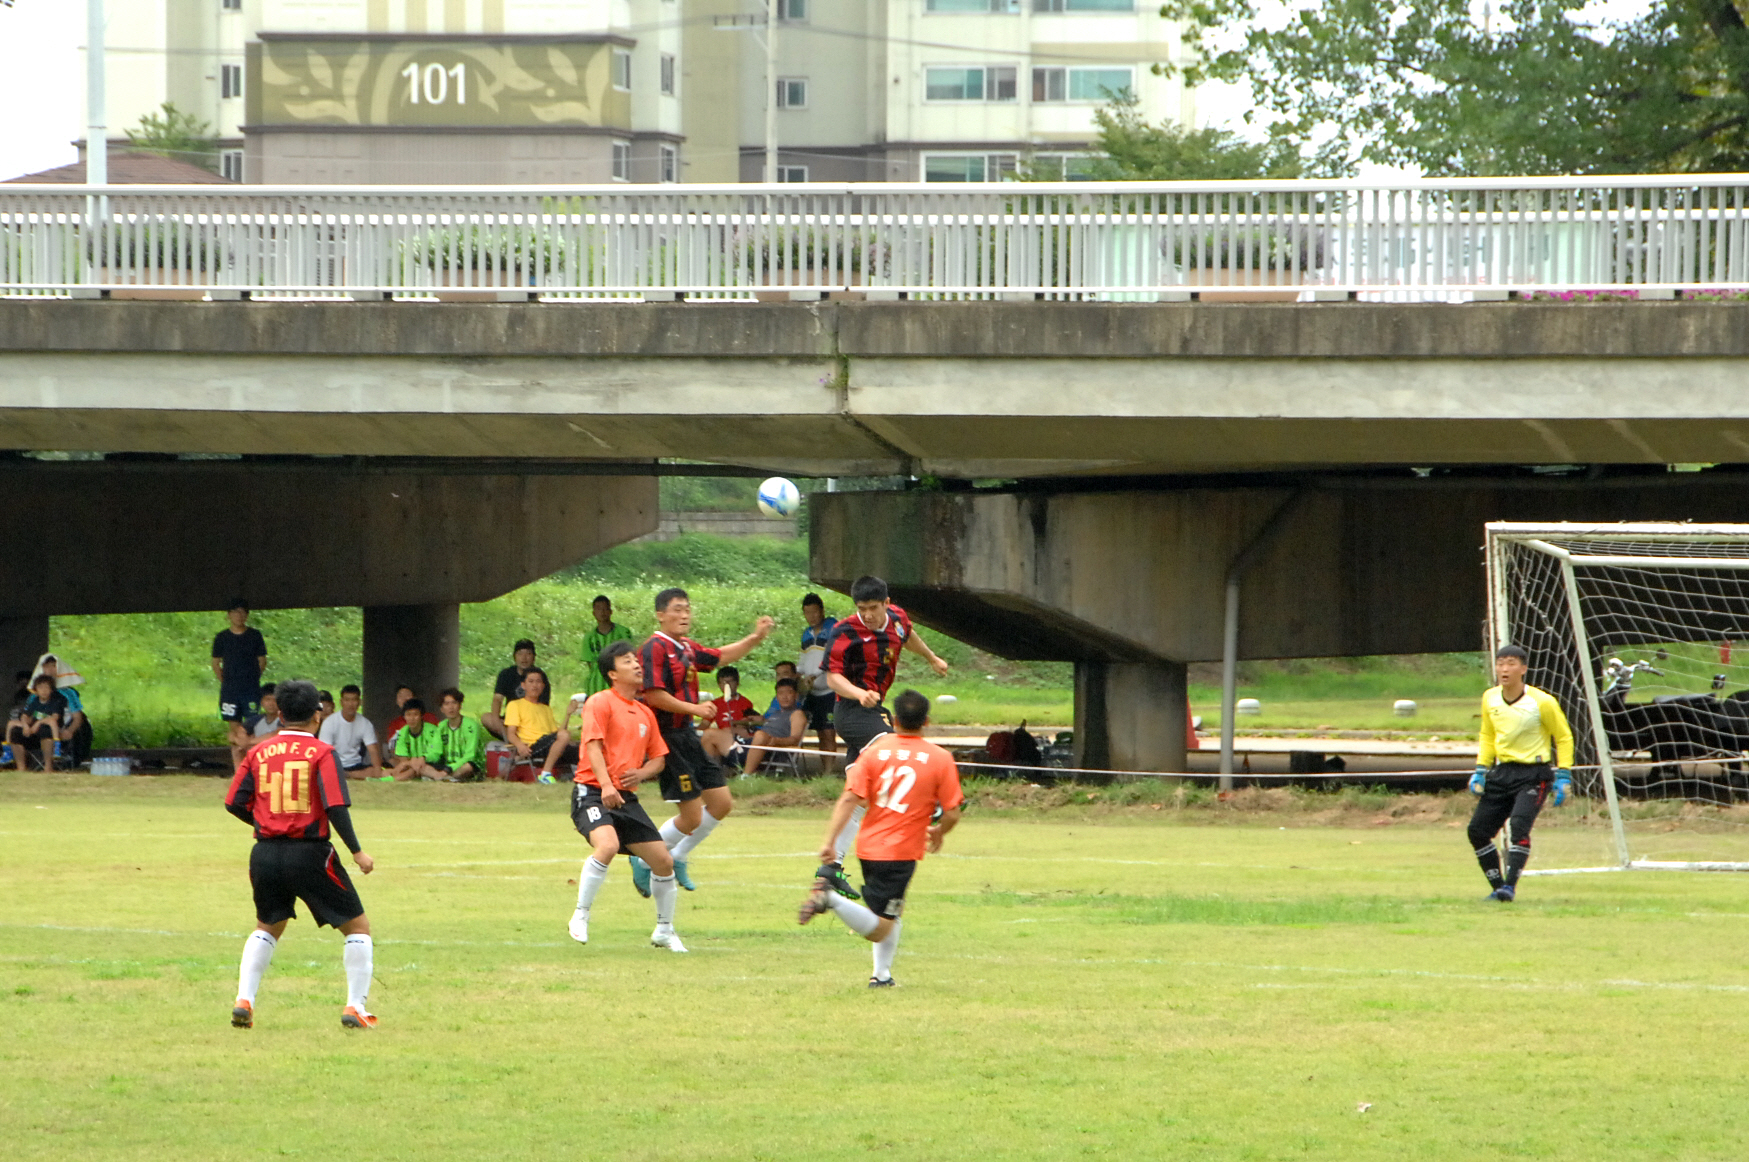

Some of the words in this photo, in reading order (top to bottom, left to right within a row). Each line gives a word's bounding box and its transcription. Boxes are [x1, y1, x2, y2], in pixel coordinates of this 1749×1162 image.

[401, 62, 466, 104] 101
[256, 742, 287, 763] LION
[259, 760, 311, 814] 40
[679, 774, 692, 792] 6
[875, 765, 917, 814] 12
[586, 806, 602, 823] 18
